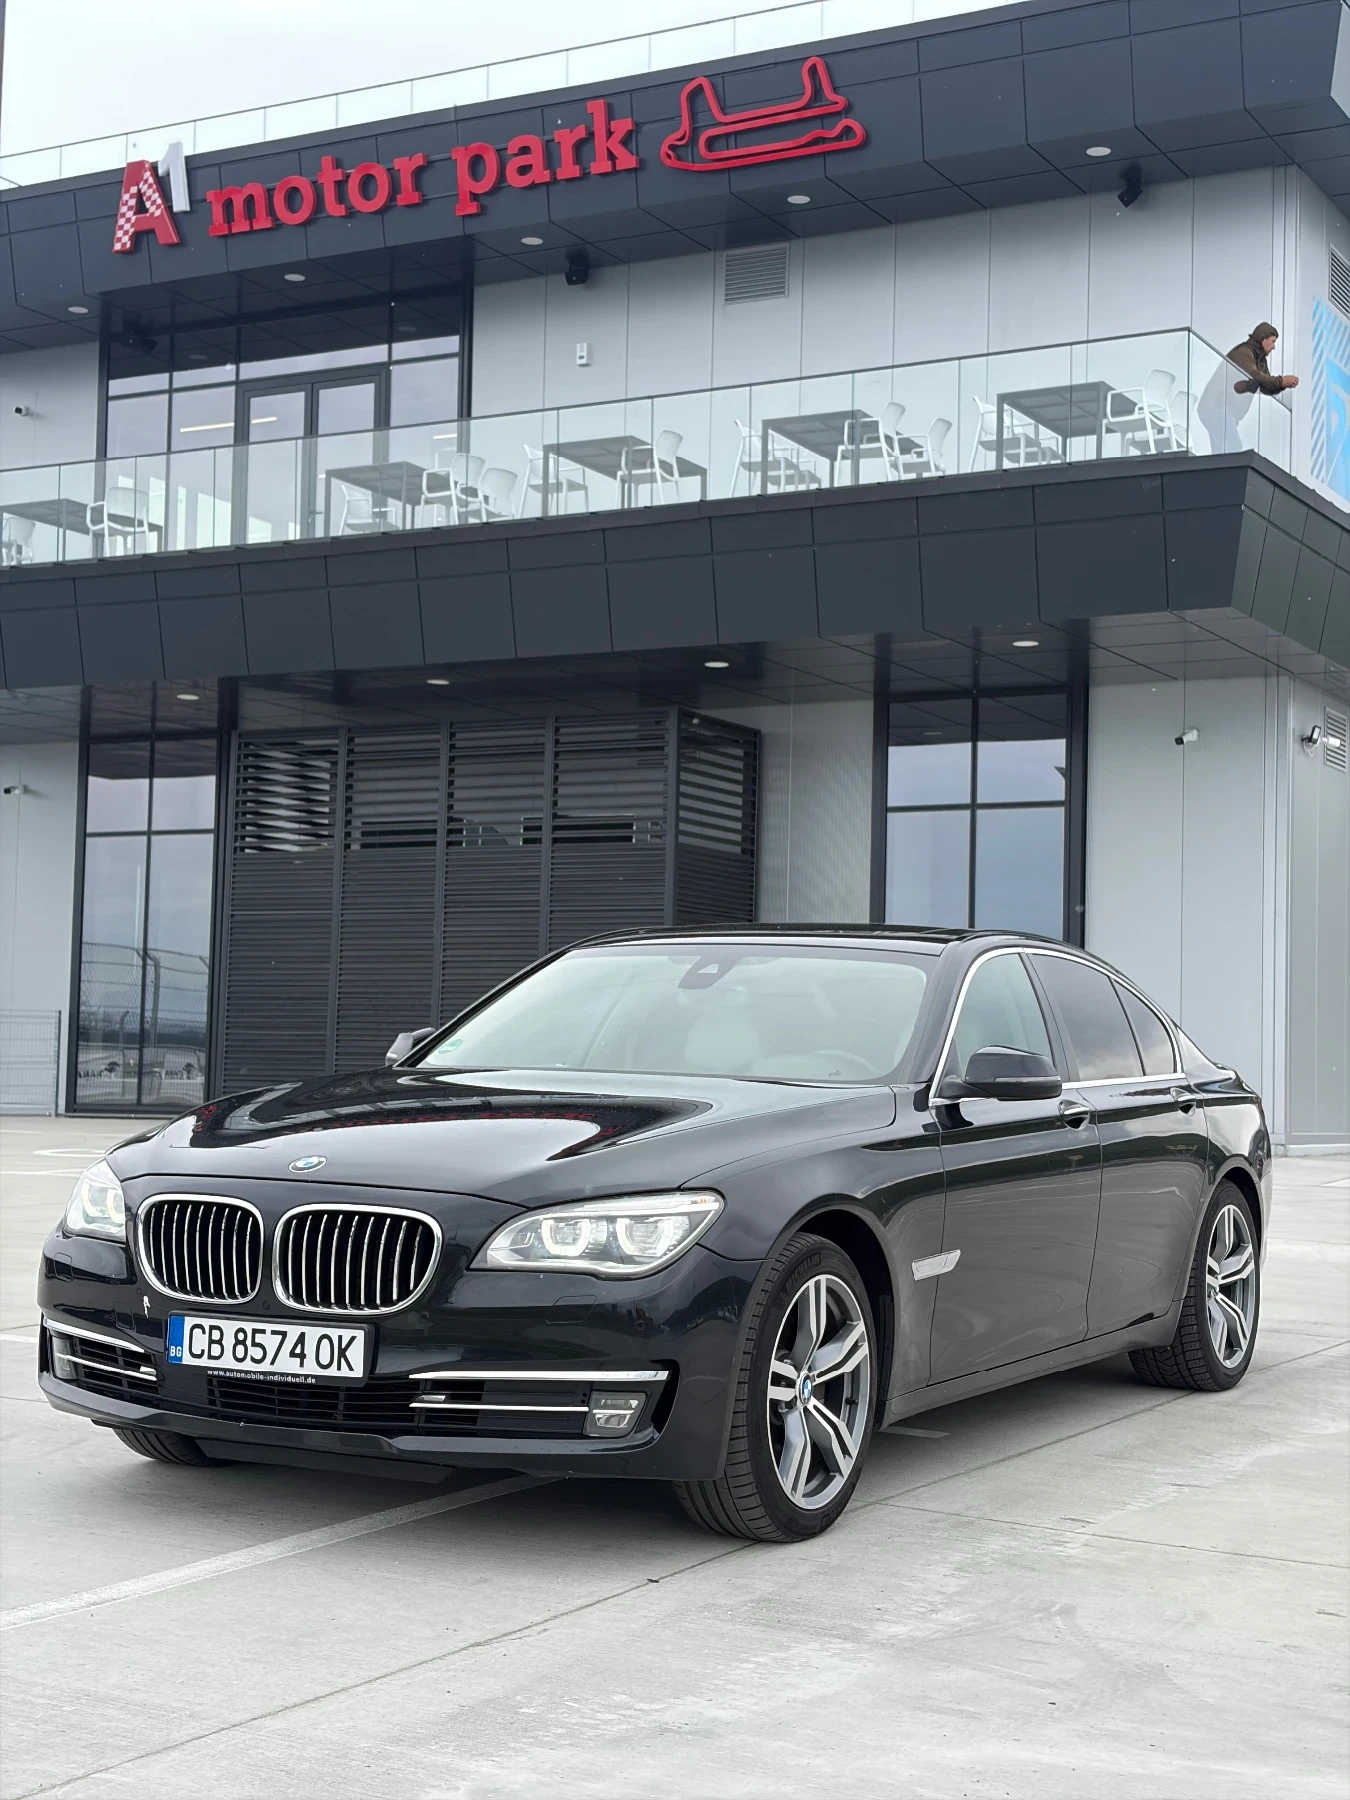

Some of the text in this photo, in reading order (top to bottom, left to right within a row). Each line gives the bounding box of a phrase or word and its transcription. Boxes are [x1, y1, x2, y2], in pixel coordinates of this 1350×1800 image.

[112, 99, 639, 253] A1 motor park
[170, 1345, 183, 1358] BG
[188, 1324, 358, 1372] CB 8574 OK
